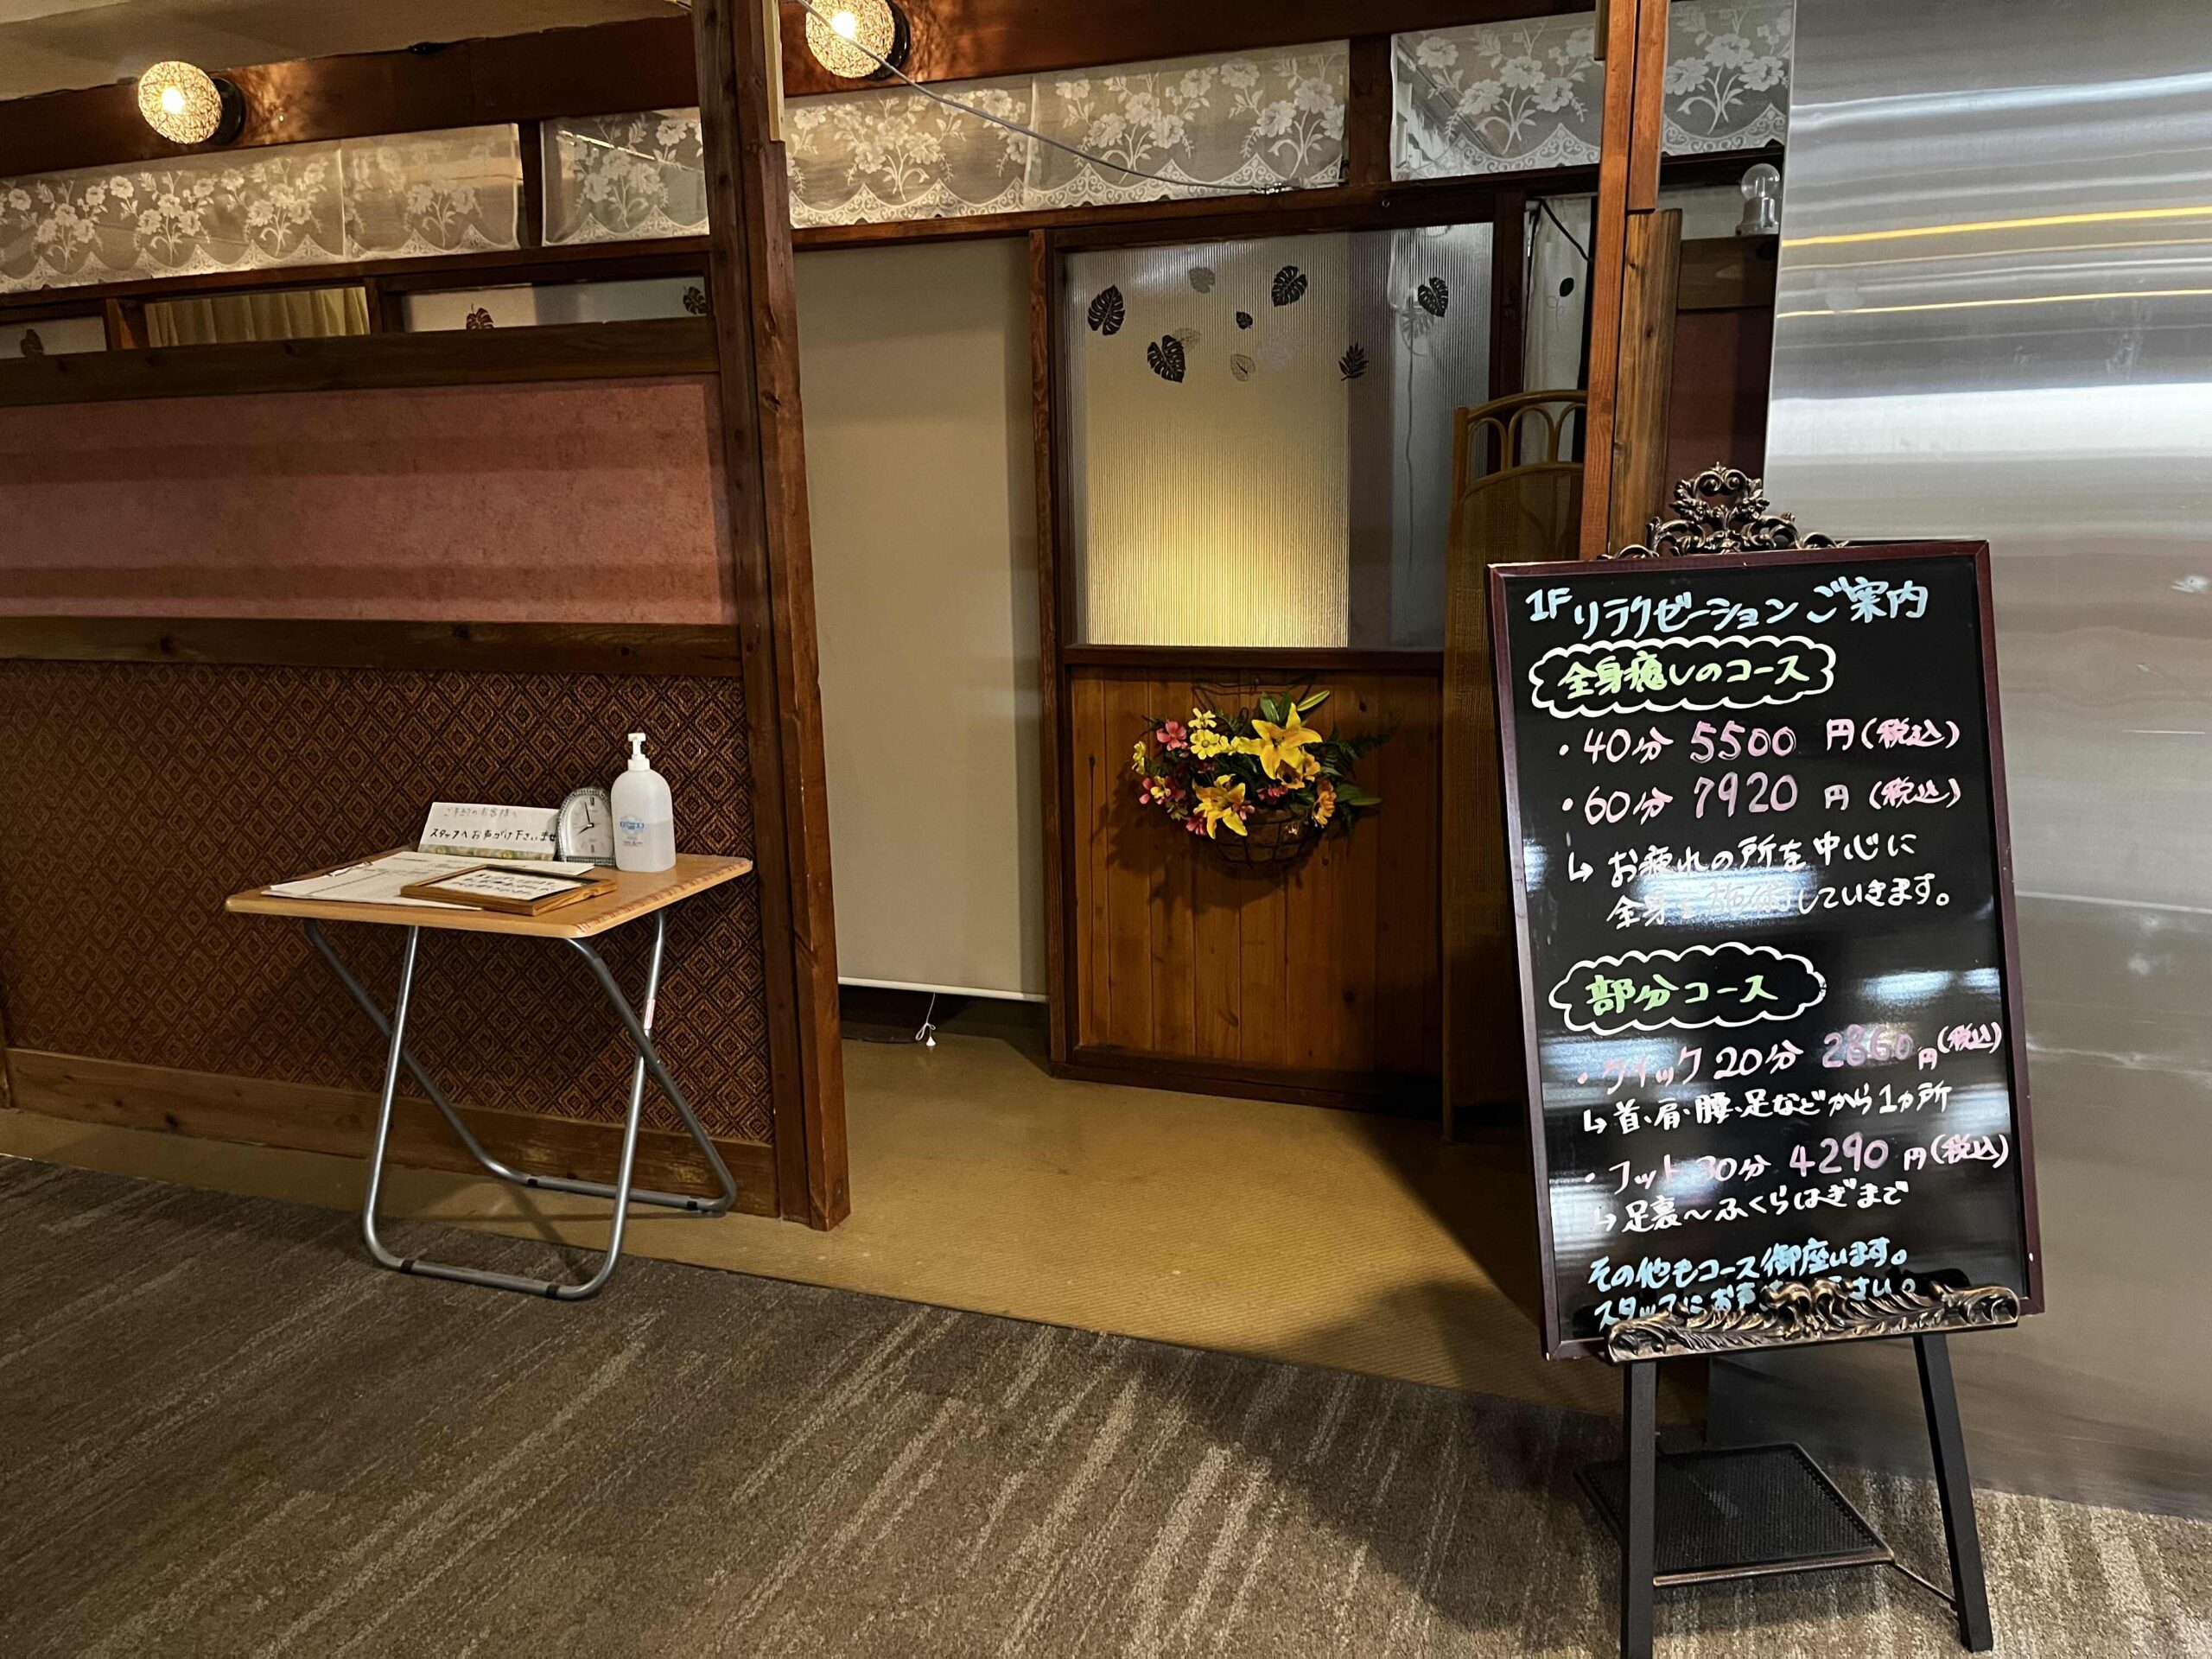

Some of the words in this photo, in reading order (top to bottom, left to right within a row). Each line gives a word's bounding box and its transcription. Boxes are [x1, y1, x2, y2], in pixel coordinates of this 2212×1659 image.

[1557, 650, 1810, 700] 全身癒しのコース
[1585, 974, 1779, 1016] 部分コース
